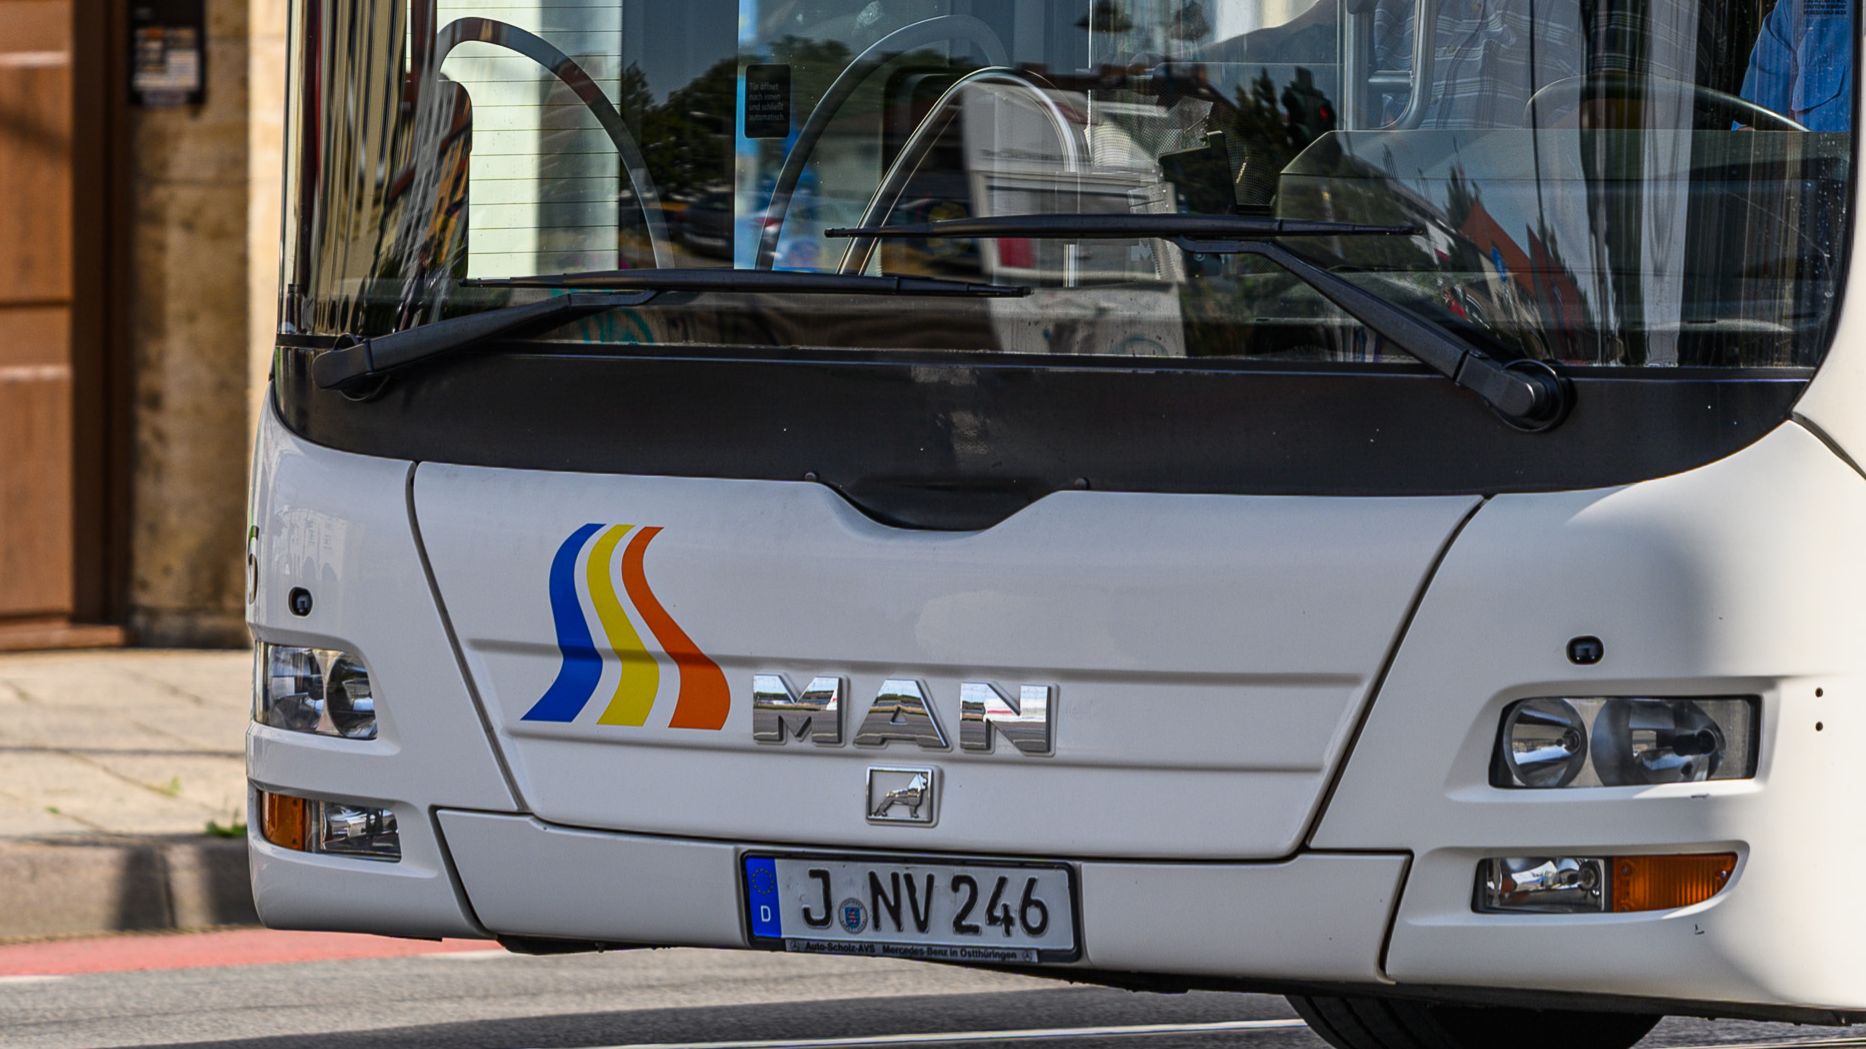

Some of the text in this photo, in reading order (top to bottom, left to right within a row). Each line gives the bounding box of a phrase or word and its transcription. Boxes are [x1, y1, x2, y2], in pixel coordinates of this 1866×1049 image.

[752, 673, 1058, 756] MAN
[760, 905, 772, 923] D
[802, 868, 833, 929] J
[868, 870, 935, 934] NV
[951, 874, 1050, 938] 246
[949, 947, 958, 957] in
[960, 948, 1017, 960] Ostthüringen
